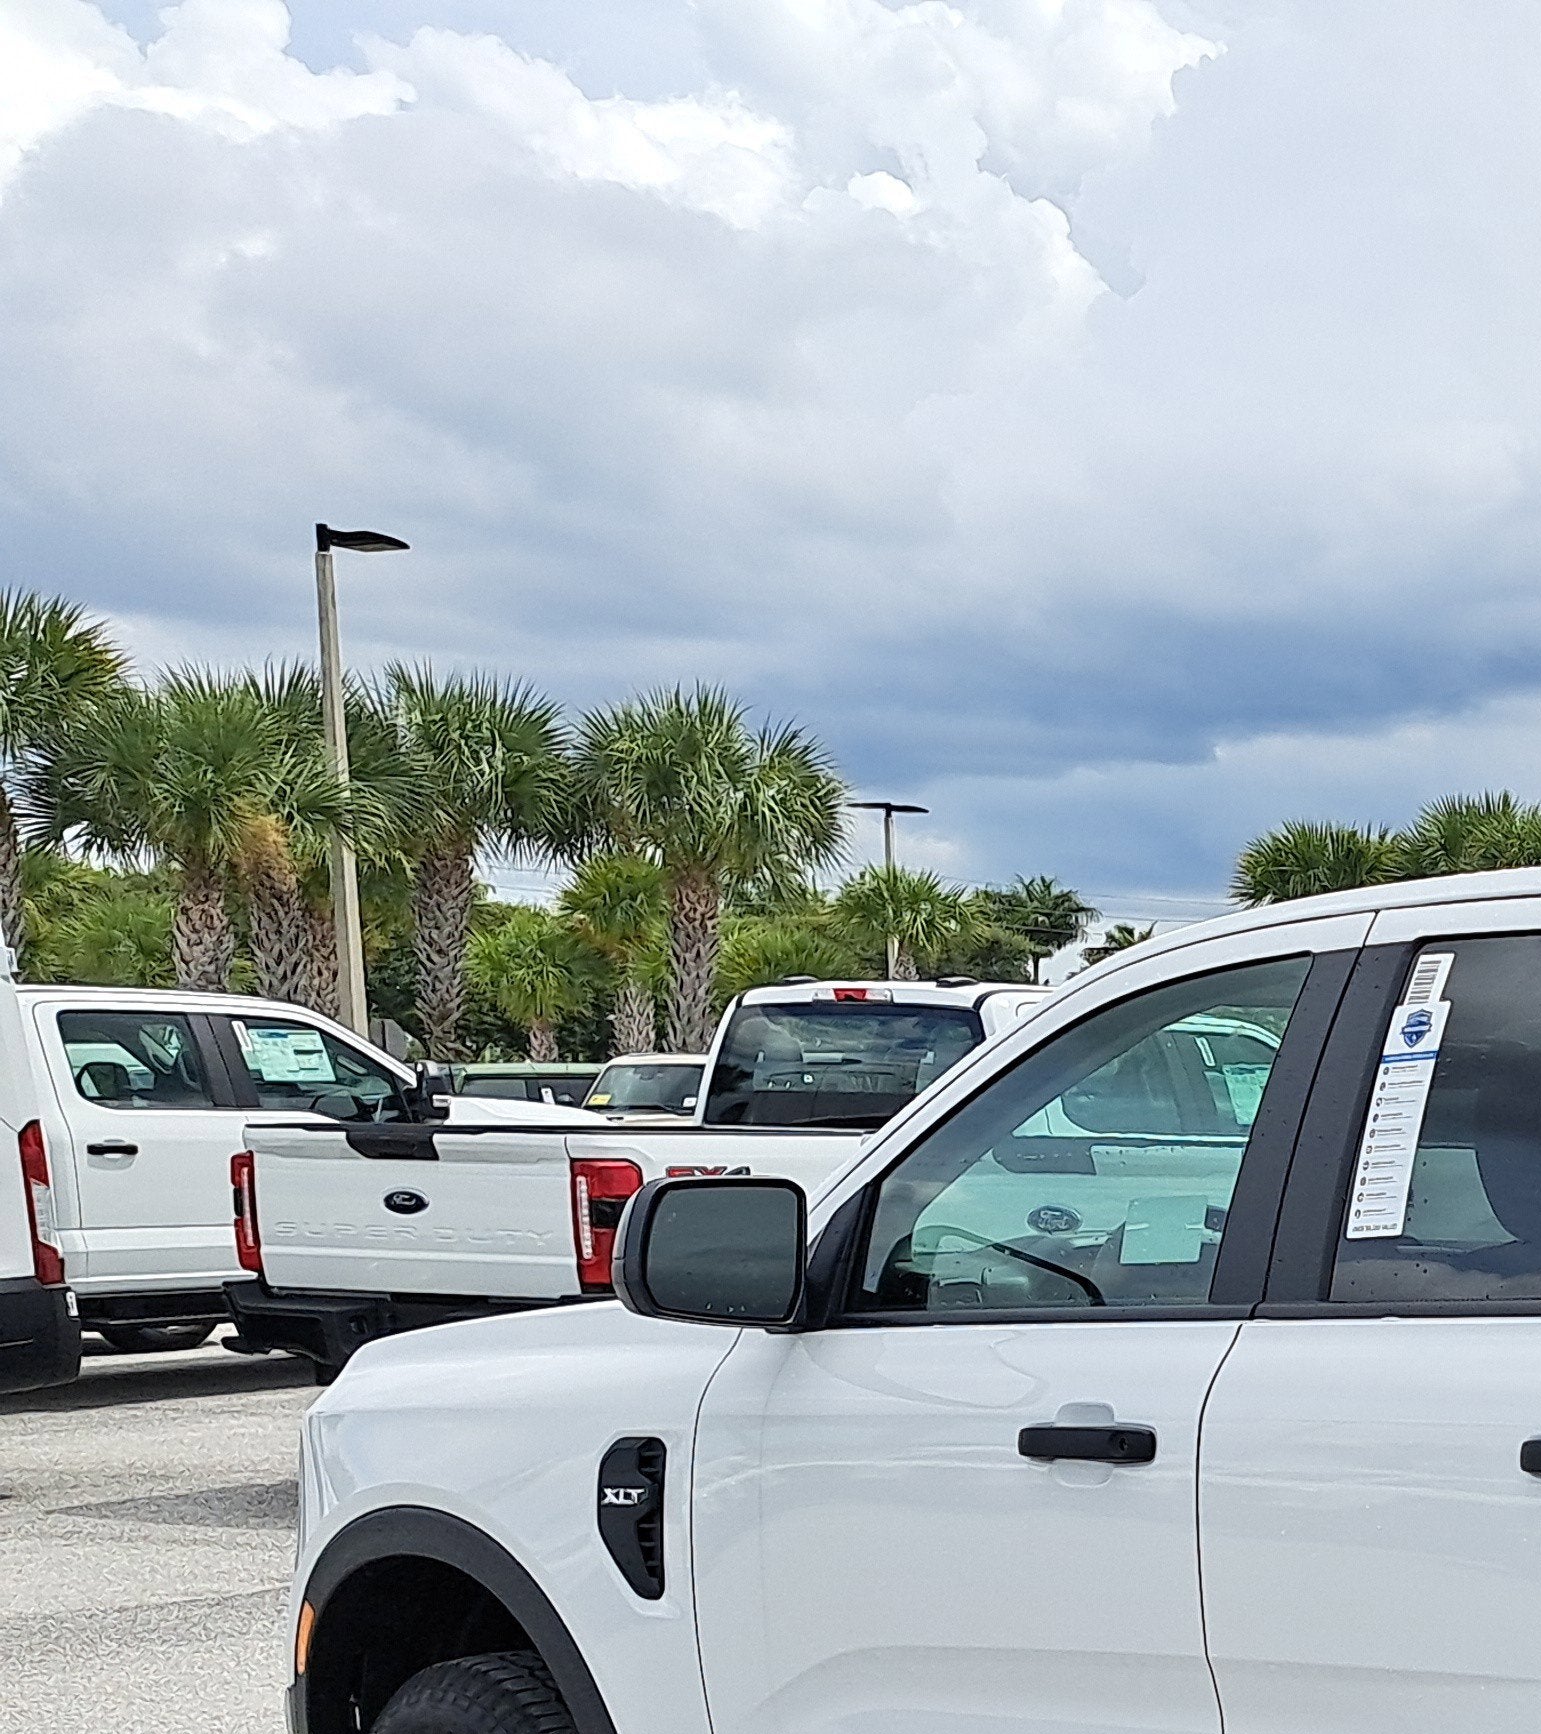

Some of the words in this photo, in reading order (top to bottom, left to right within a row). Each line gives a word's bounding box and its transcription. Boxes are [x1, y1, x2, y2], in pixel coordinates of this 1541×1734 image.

[274, 1221, 418, 1240] SUPER
[432, 1226, 553, 1246] DUTY
[600, 1488, 645, 1505] XLT
